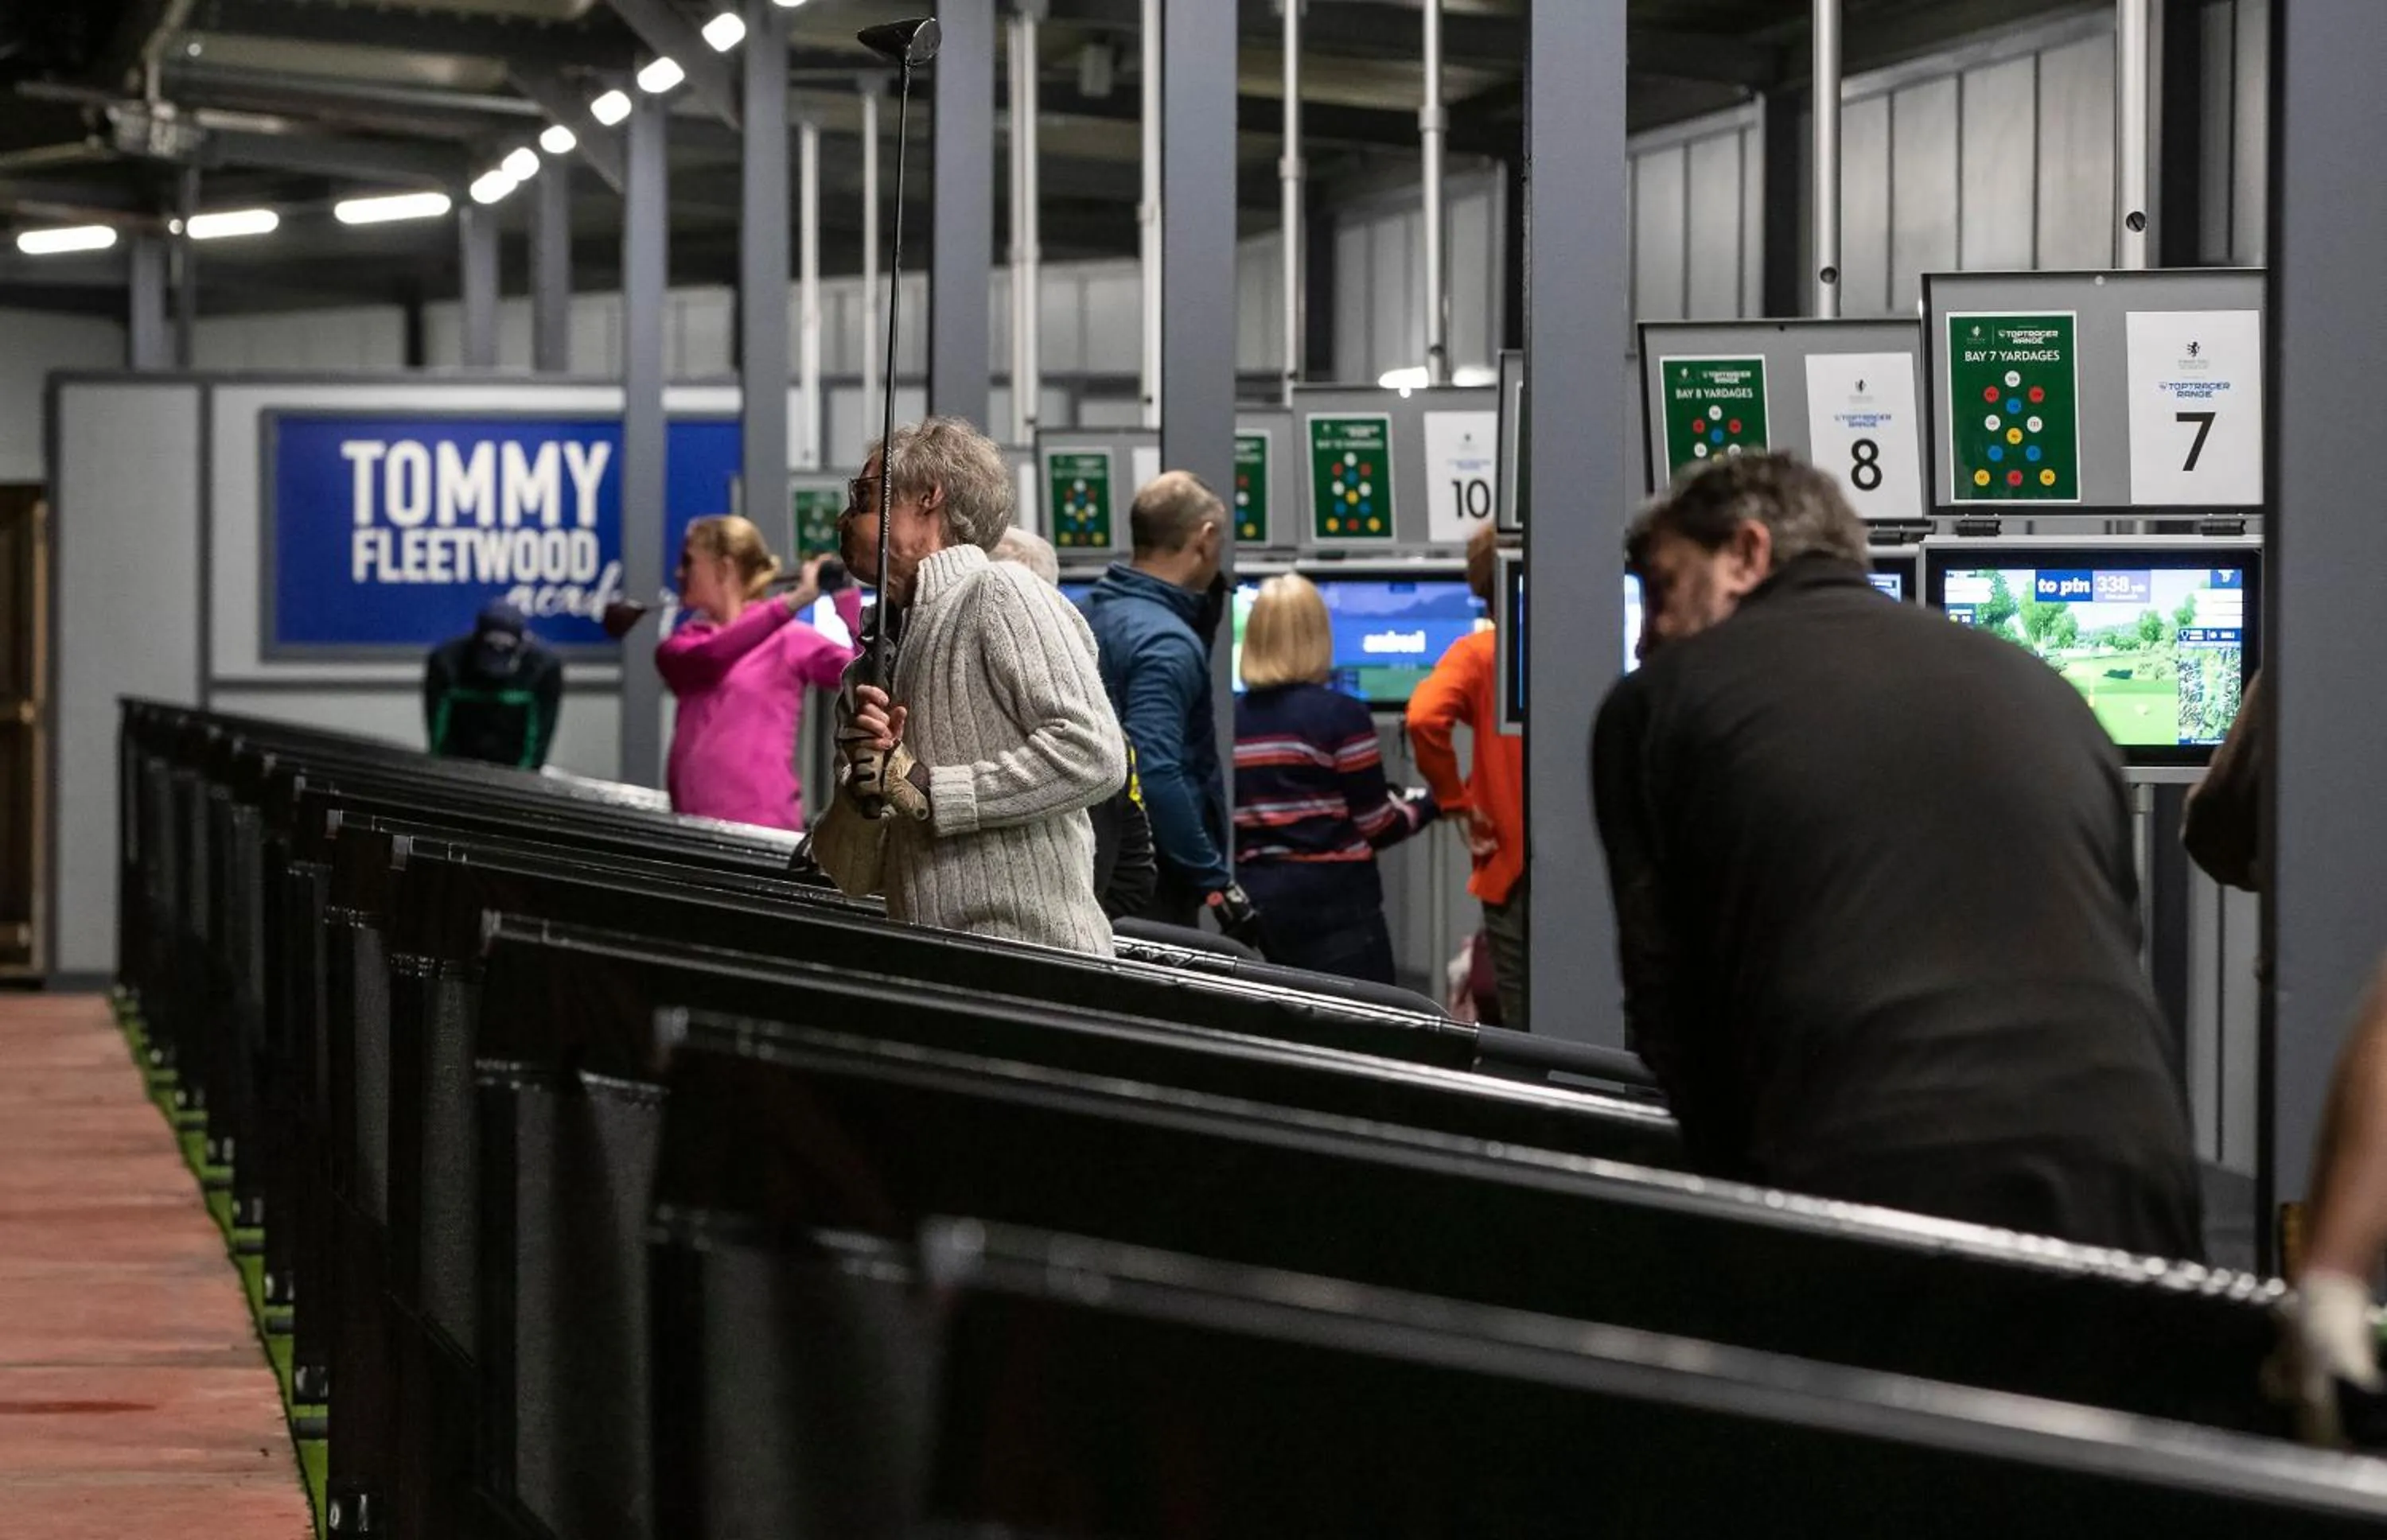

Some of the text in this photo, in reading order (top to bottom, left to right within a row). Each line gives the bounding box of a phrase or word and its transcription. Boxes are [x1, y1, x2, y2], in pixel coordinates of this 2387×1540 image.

[1965, 350, 2060, 362] BAY 7 YARDAGES
[2168, 382, 2230, 391] TOPTRACER
[1851, 438, 1883, 492] 8
[2176, 411, 2216, 472] 7
[341, 440, 612, 527] TOMMY
[1451, 479, 1490, 519] 10
[352, 527, 599, 583] FLEETWOOD
[2038, 578, 2058, 593] to
